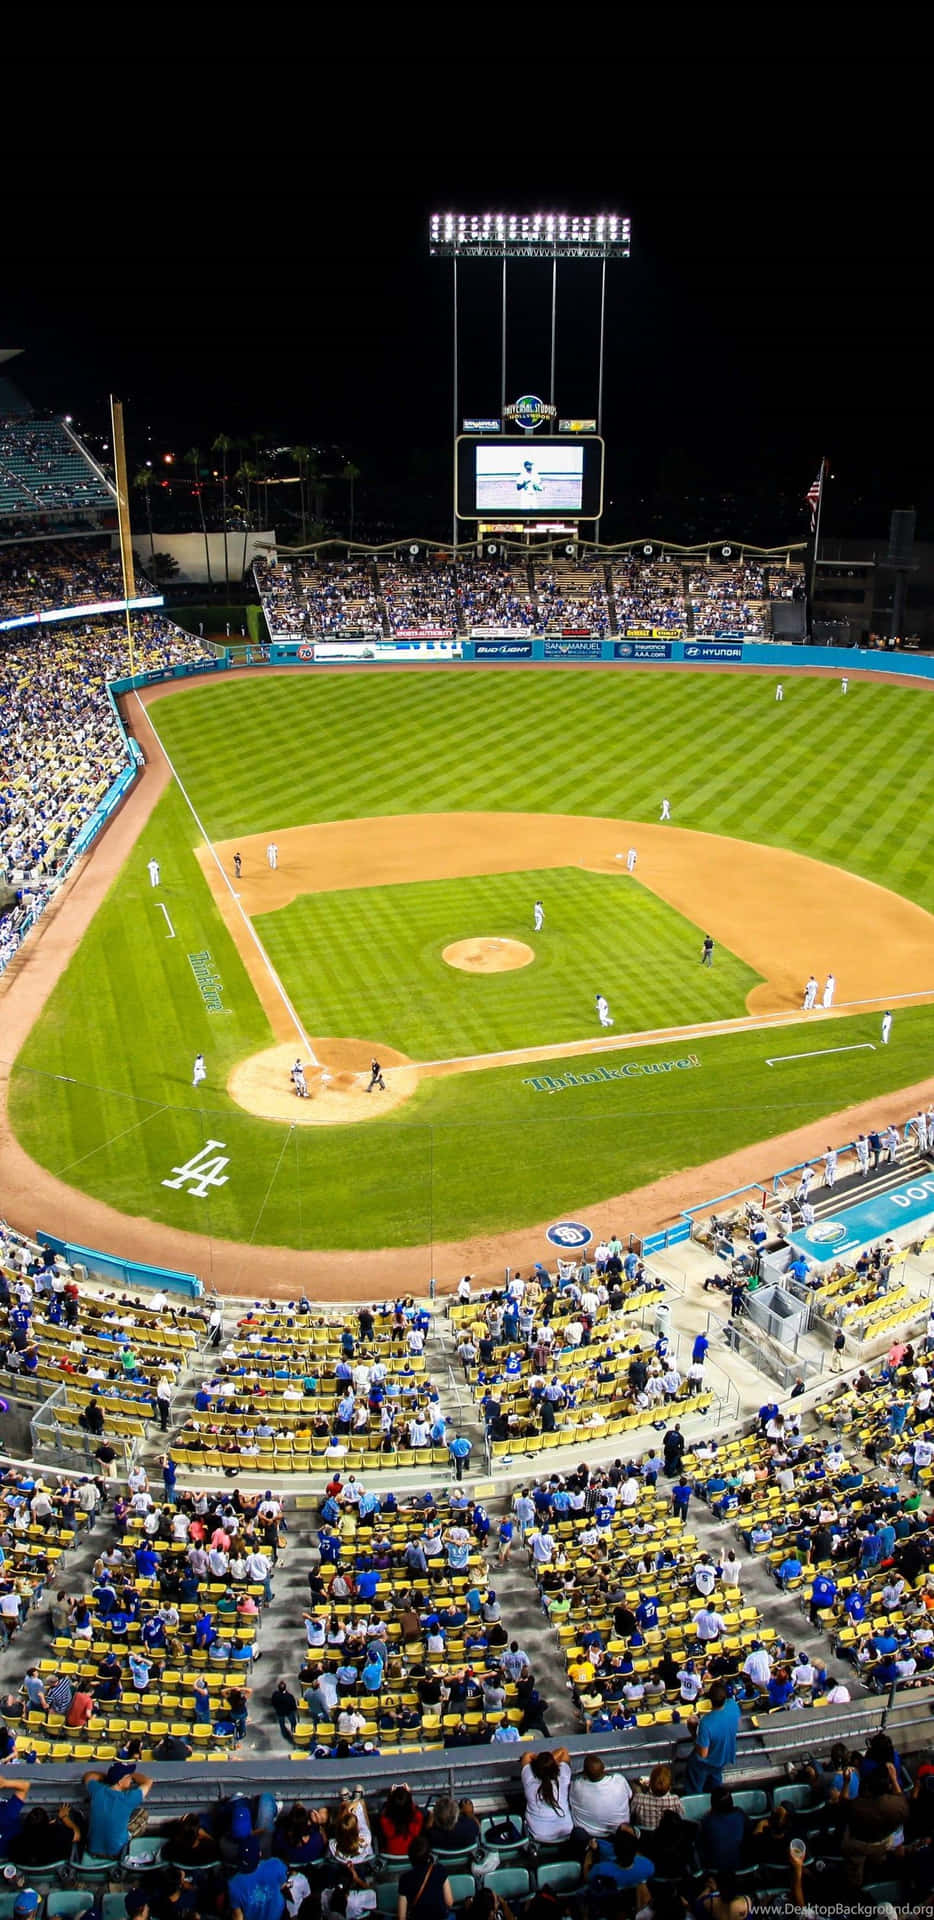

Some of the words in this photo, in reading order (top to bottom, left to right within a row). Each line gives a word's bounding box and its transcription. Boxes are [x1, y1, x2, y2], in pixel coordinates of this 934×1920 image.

[534, 404, 557, 416] STUDIOS
[500, 645, 530, 654] LIGHT
[544, 642, 561, 650] SAN
[567, 642, 600, 650] MANUEL
[301, 649, 311, 657] 76
[702, 648, 741, 656] HYUNDAI
[522, 1055, 701, 1092] ThinkCure!
[161, 1139, 231, 1198] LA
